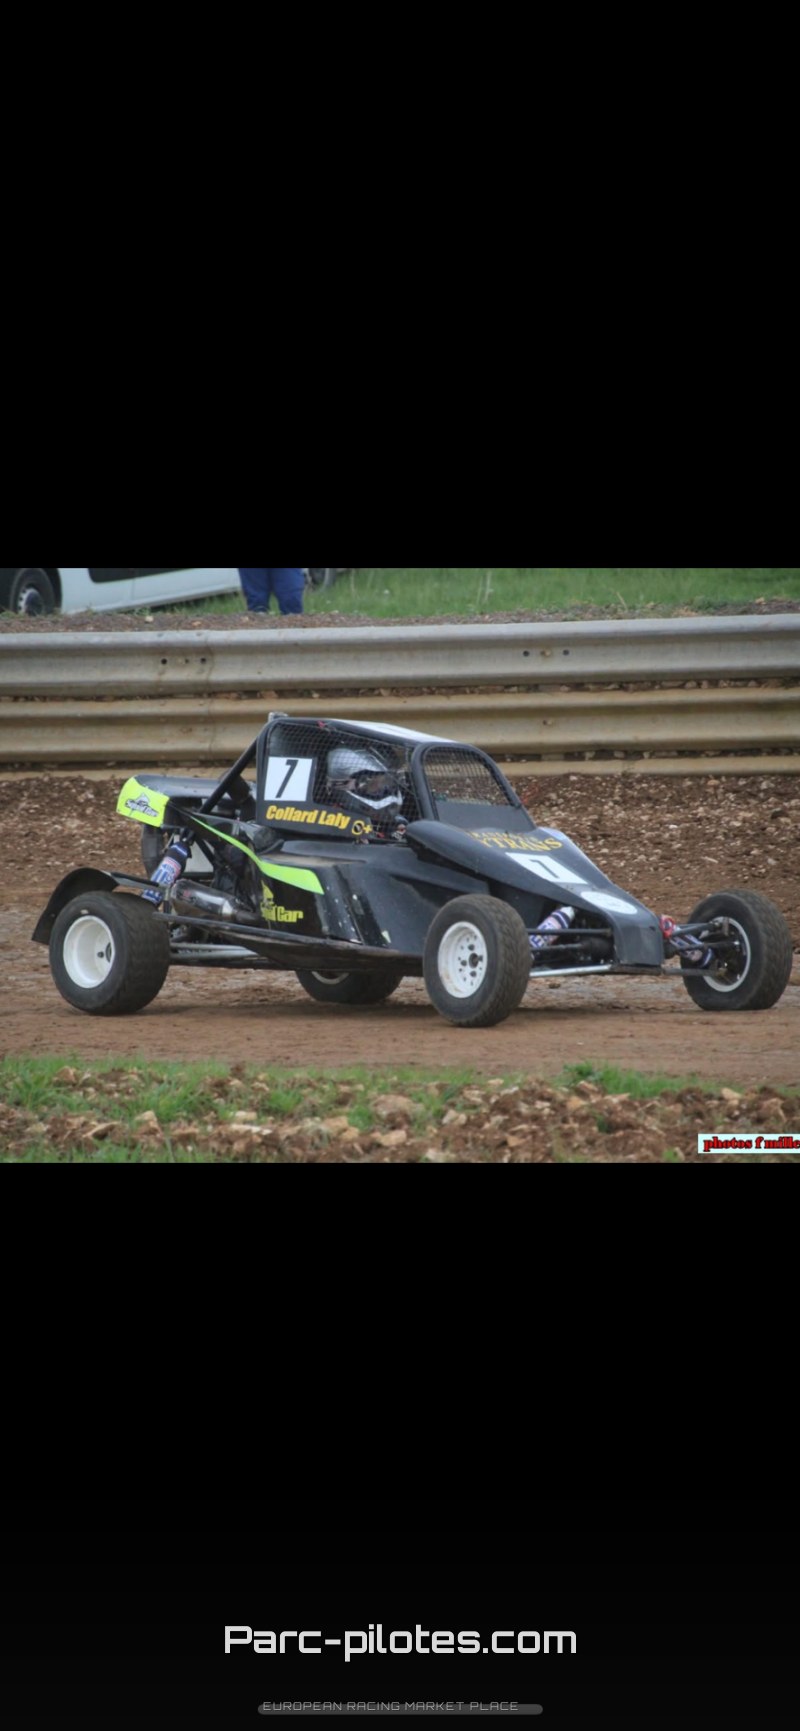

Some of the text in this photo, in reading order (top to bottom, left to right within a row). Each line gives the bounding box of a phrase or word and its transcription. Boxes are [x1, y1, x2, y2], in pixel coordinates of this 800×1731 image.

[275, 759, 299, 799] 7
[266, 805, 318, 824] Collard
[318, 811, 351, 830] Laly
